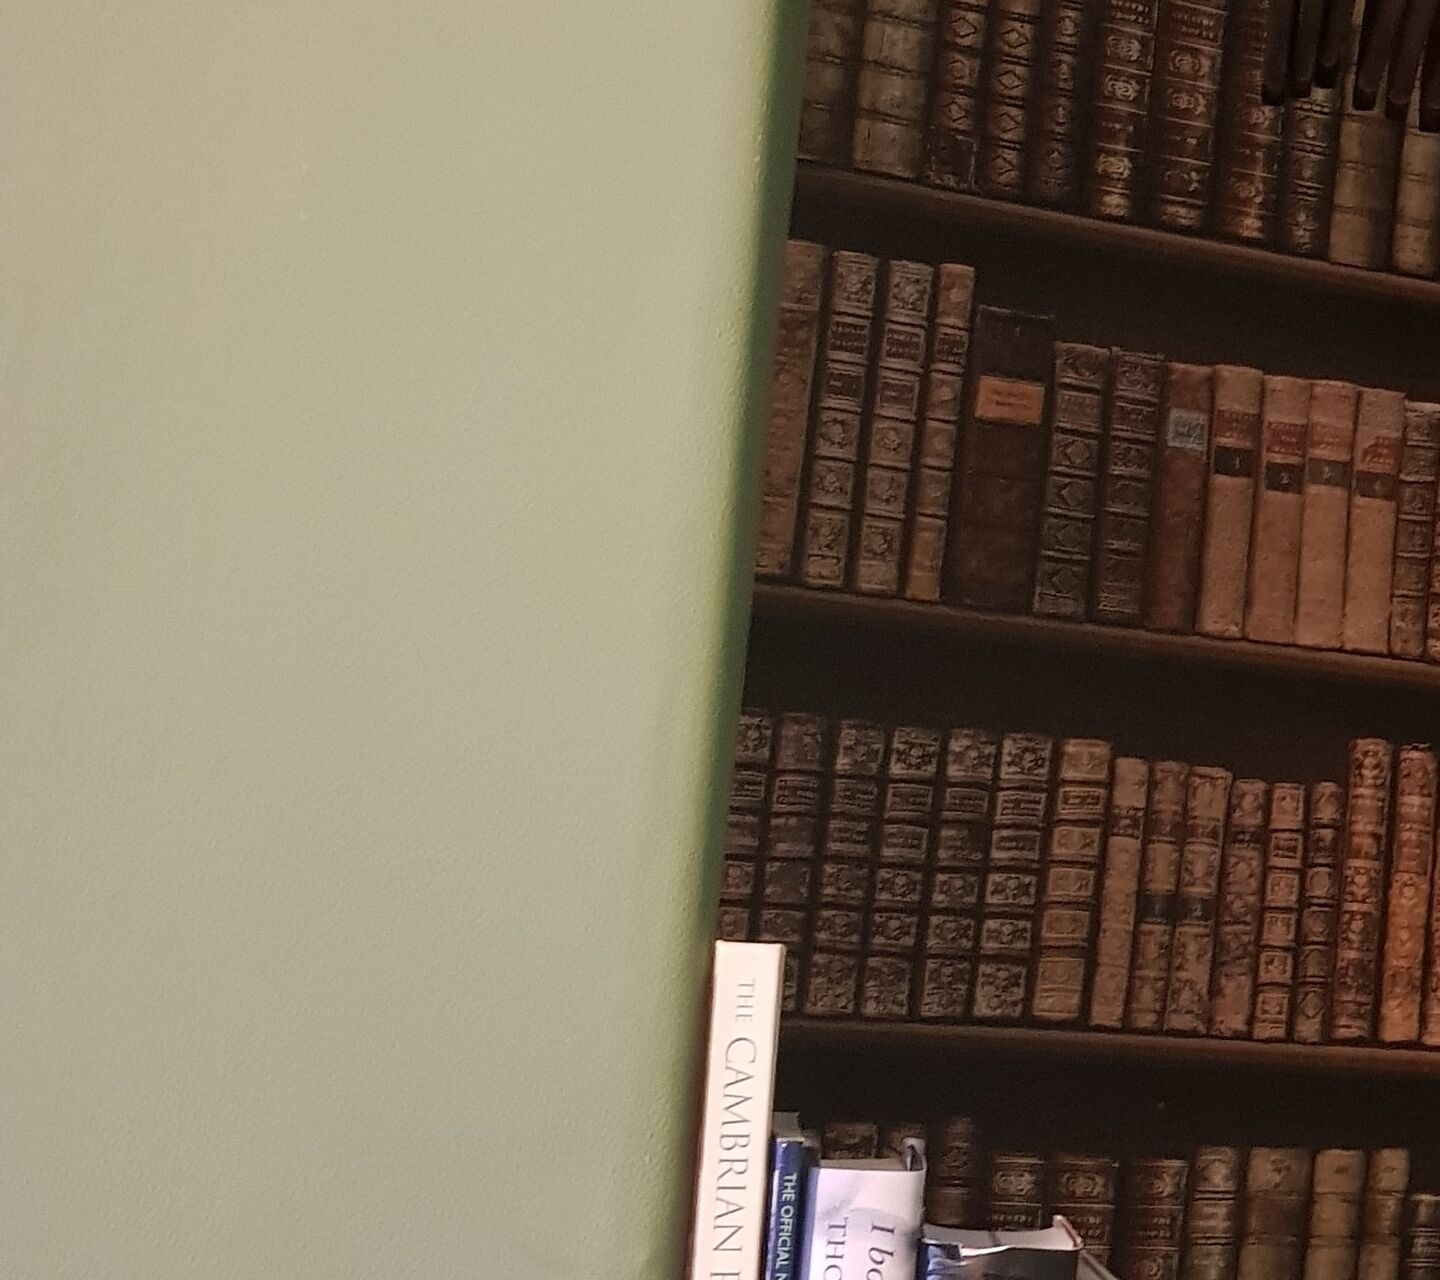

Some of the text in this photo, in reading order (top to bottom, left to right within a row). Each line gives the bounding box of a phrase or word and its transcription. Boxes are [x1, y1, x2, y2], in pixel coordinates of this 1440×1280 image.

[734, 979, 756, 1022] THE
[710, 1037, 756, 1252] CAMBRIAN
[780, 1173, 796, 1200] THE
[774, 1205, 794, 1269] OFFICIAL
[870, 1222, 896, 1233] I
